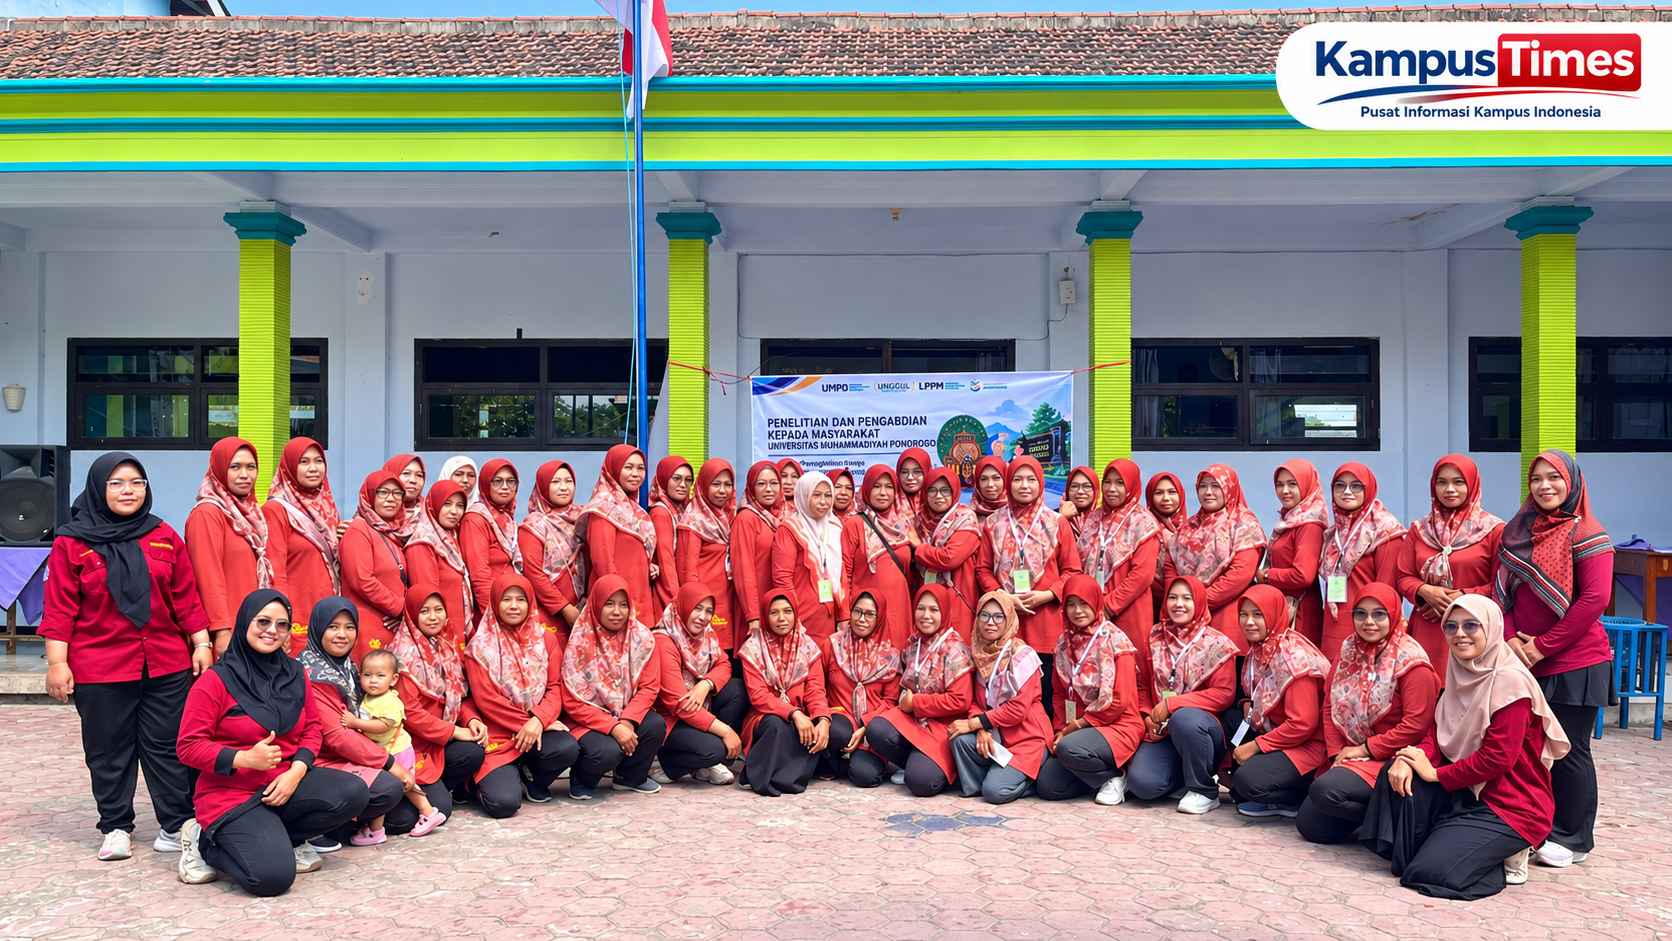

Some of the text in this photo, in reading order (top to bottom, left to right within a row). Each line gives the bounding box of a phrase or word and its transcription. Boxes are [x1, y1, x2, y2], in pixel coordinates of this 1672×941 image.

[821, 383, 848, 393] UMPO
[918, 382, 944, 390] LPPM
[767, 415, 927, 428] PENELITIAN DAN PENGABDIAN
[767, 428, 880, 440] KEPADA MASYARAKAT
[767, 439, 936, 450] UNIVERSITAS MUHAMMADIYAH PONOROGO
